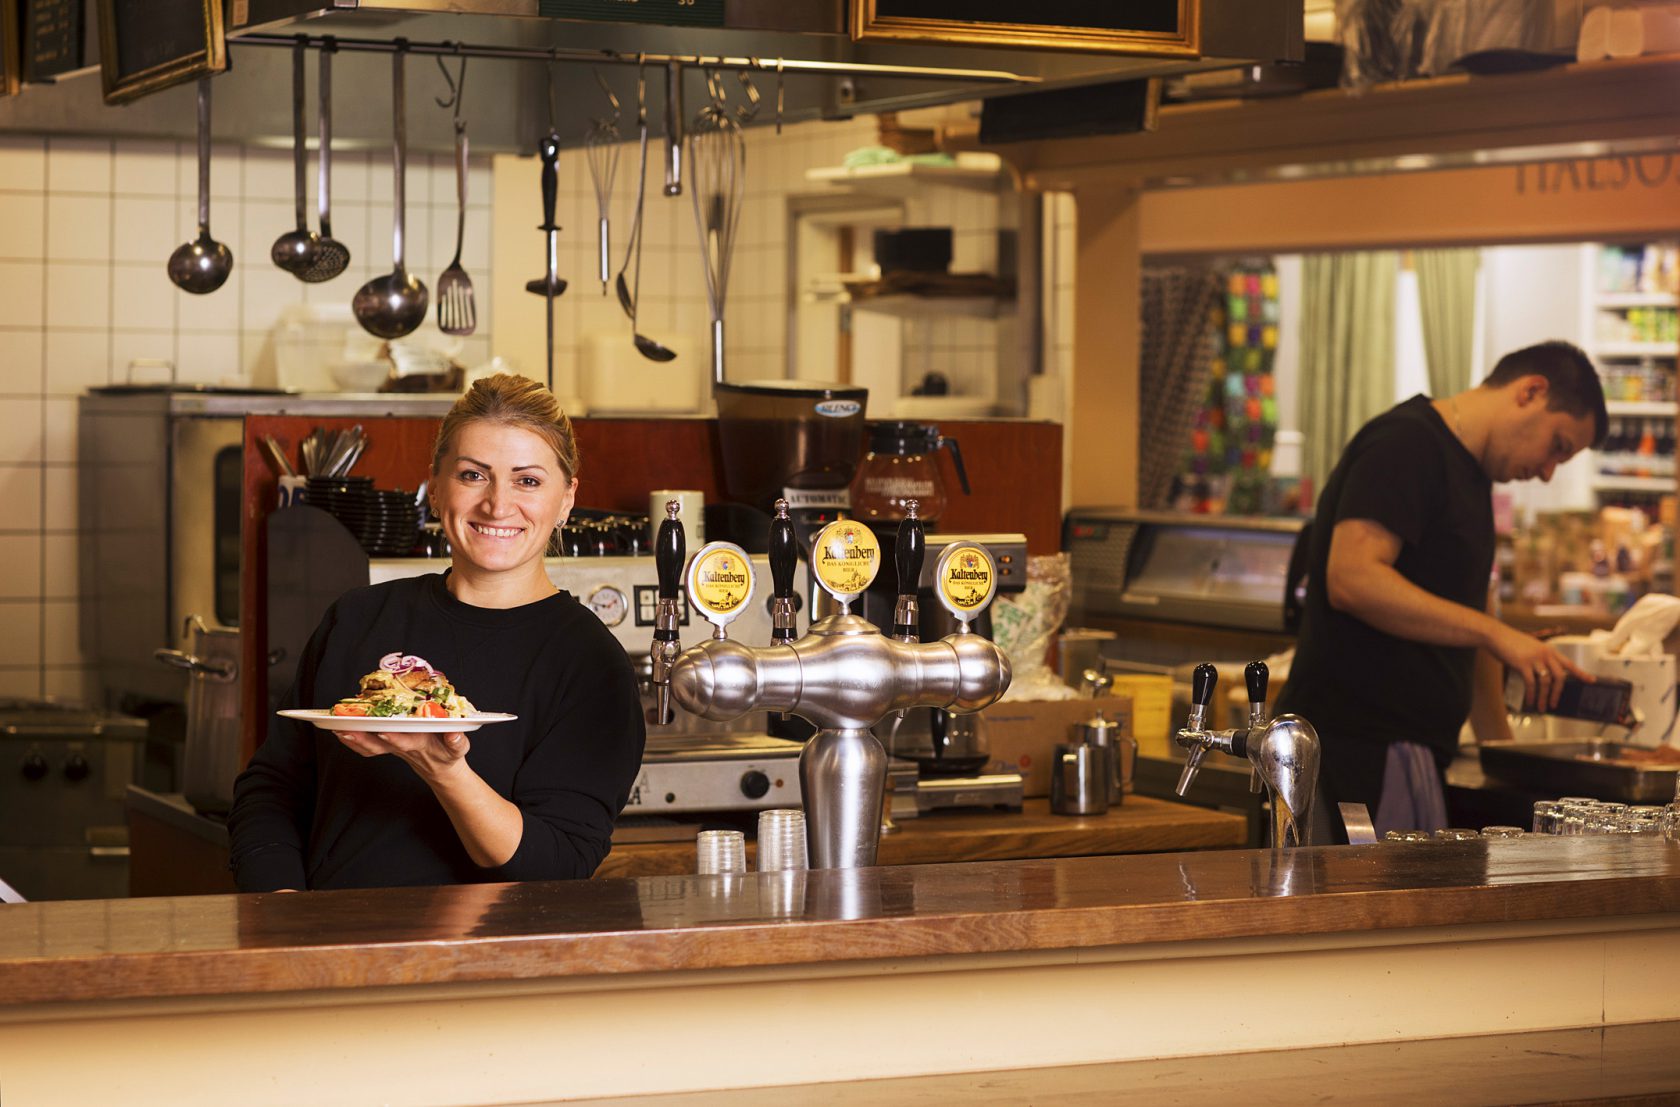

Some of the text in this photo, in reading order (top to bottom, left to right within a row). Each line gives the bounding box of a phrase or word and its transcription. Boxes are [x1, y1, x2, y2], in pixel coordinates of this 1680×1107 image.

[822, 545, 875, 564] Kaenberg
[702, 570, 745, 586] Kaltenberg
[949, 568, 988, 584] Kaltenberg
